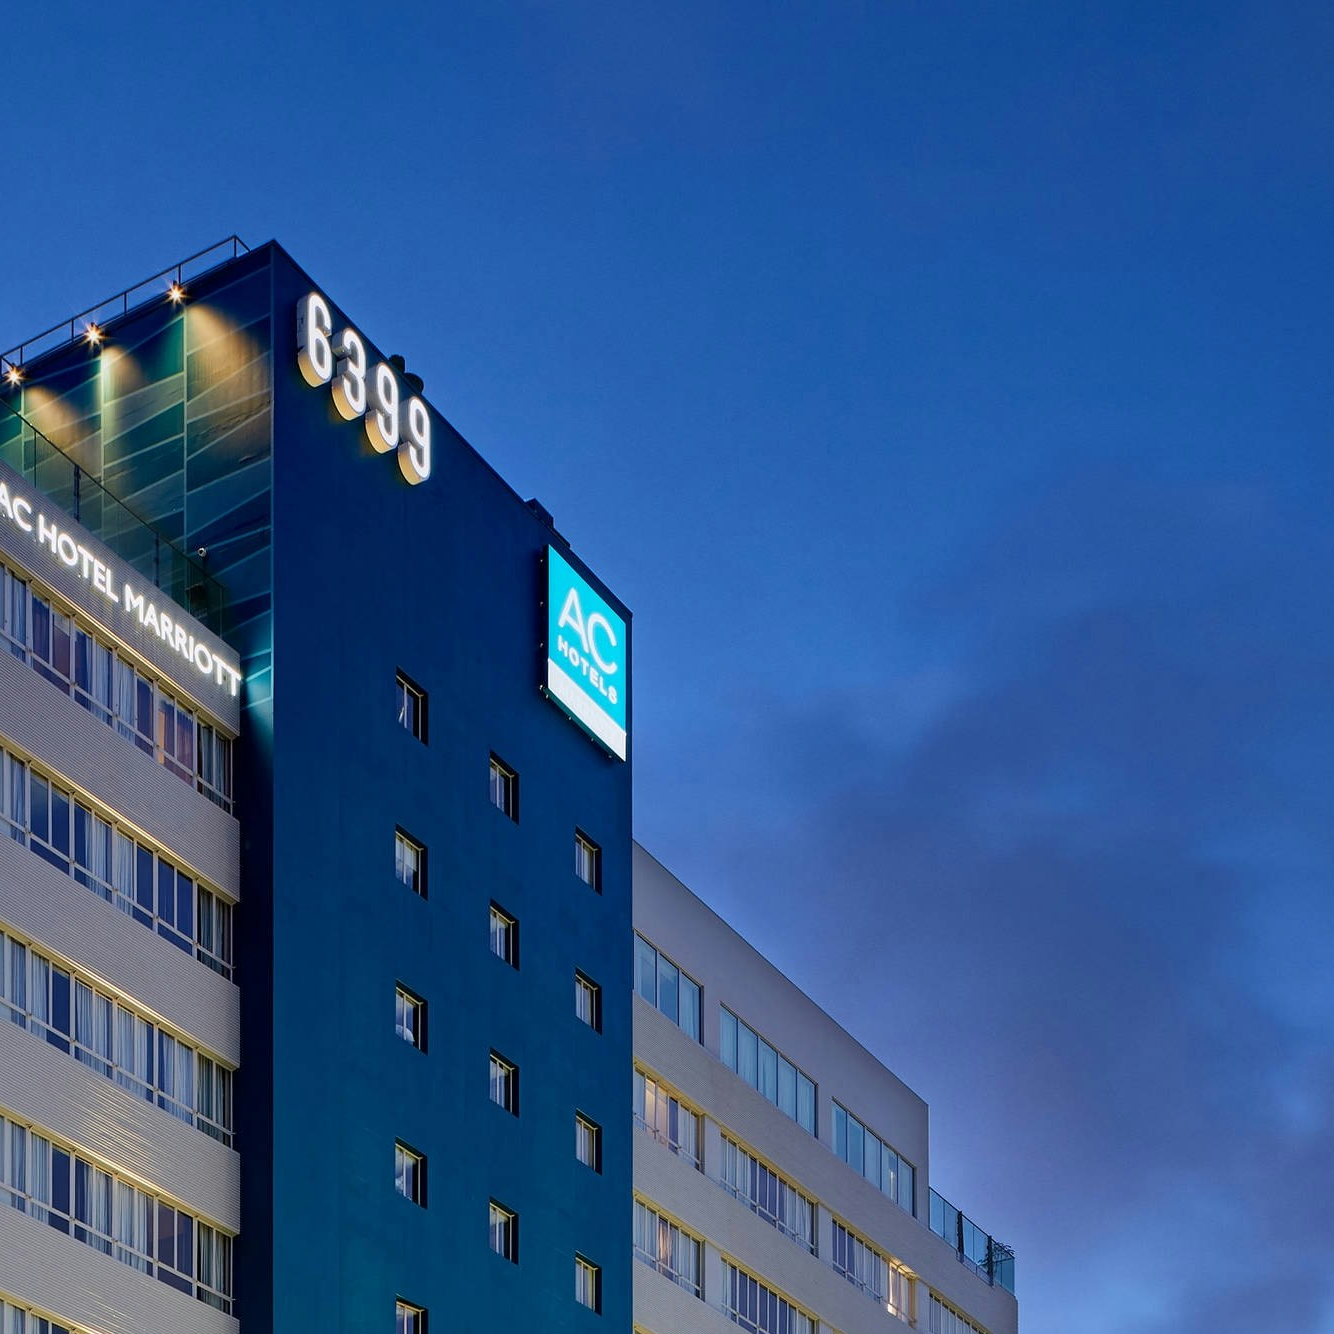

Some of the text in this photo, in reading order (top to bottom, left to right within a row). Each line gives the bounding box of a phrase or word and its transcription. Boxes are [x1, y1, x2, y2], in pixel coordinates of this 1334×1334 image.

[299, 292, 431, 484] 6399
[37, 514, 119, 602] HOTEL
[124, 583, 242, 697] MARRIOTT
[556, 634, 618, 705] HOTELS
[557, 587, 618, 675] AC
